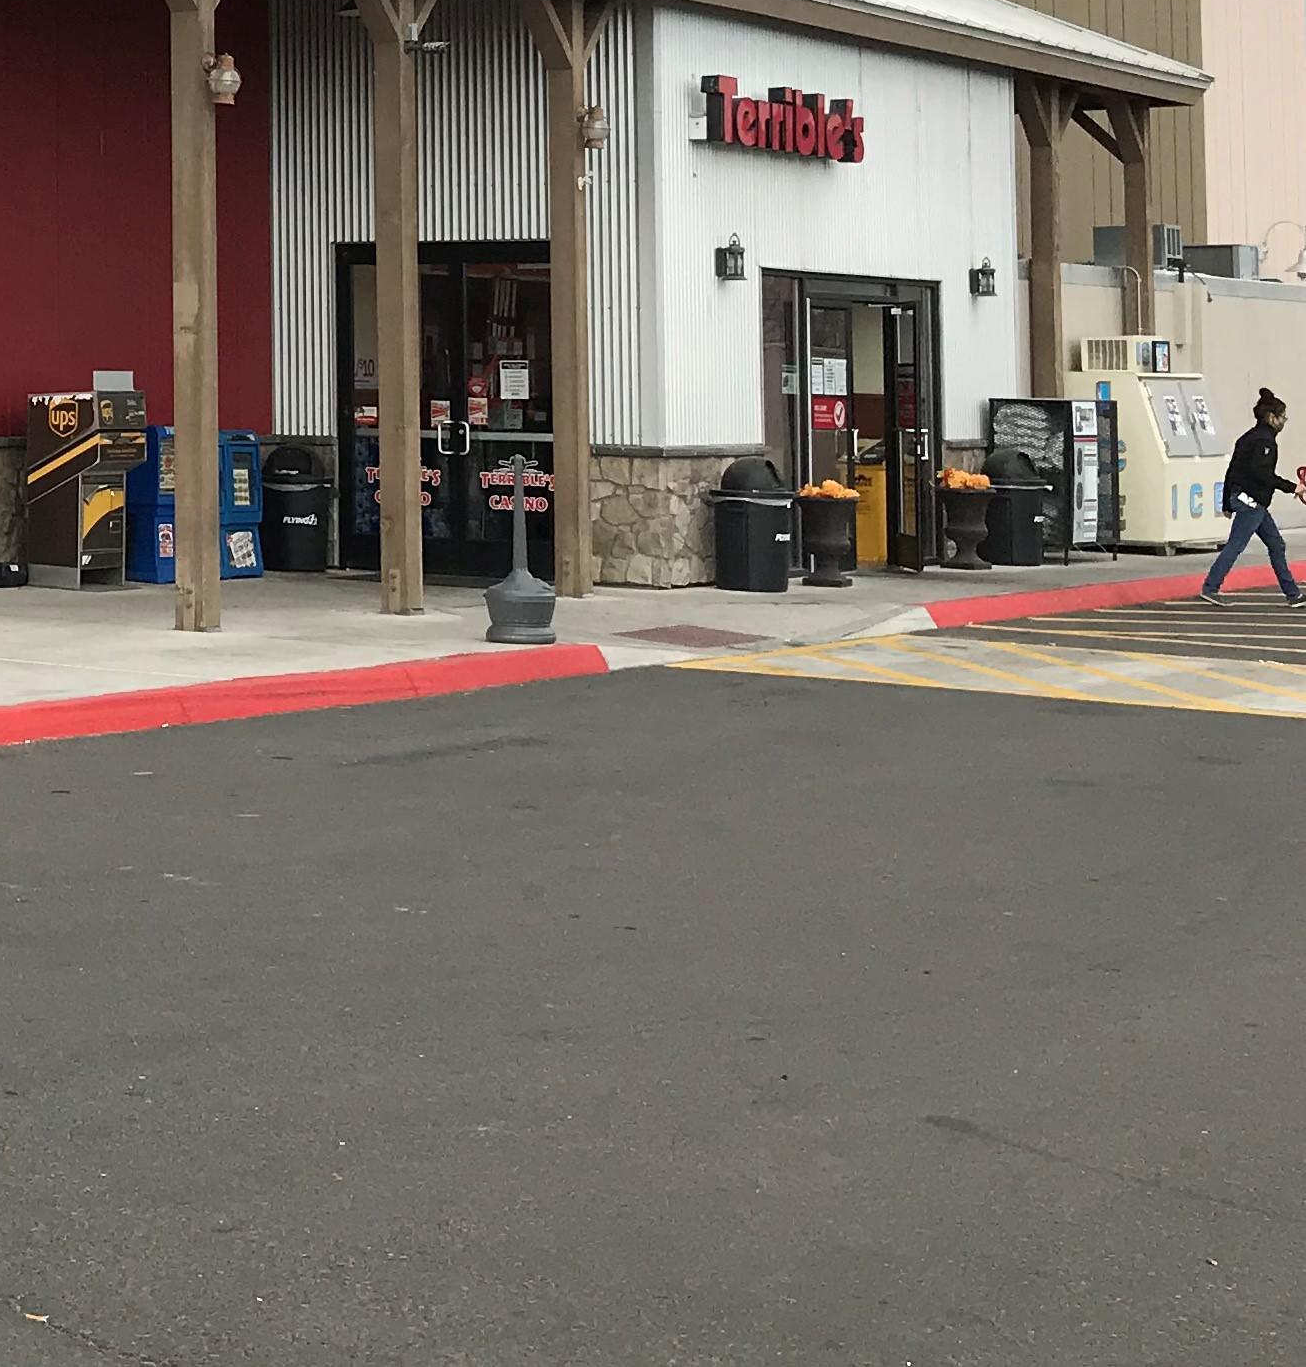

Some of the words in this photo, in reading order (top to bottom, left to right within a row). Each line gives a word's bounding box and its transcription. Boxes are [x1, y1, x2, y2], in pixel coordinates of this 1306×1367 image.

[713, 74, 865, 164] Terrible's
[51, 410, 76, 431] ups
[480, 471, 555, 491] TERRBLE'S
[489, 495, 548, 512] CASNO
